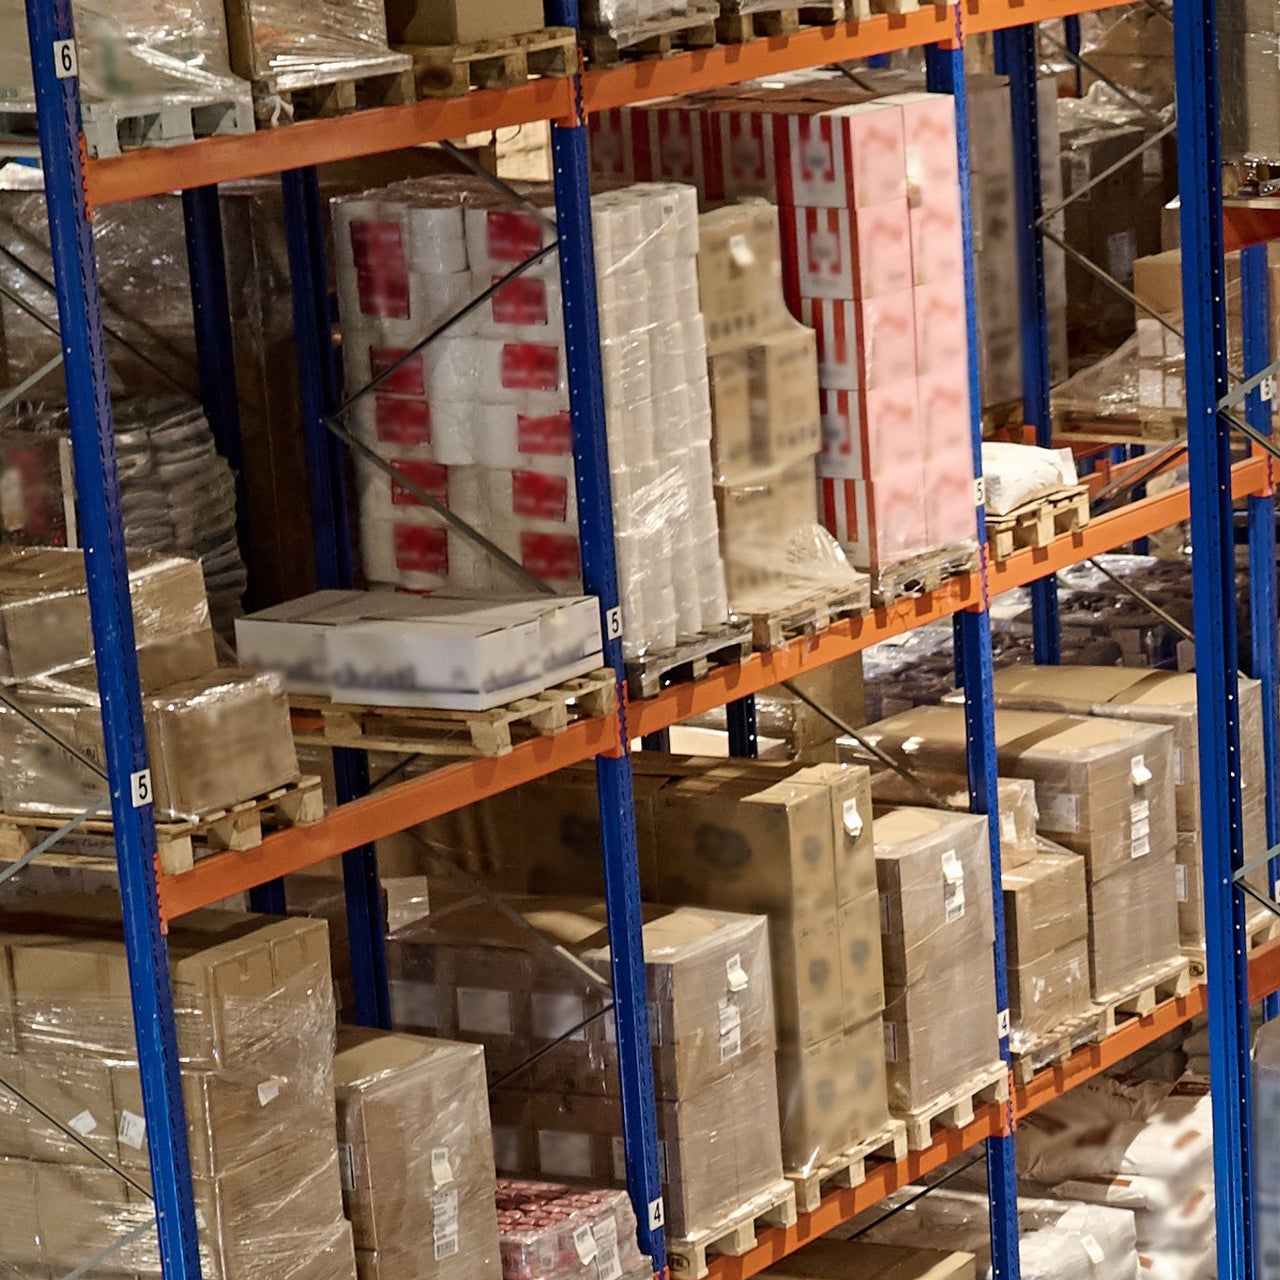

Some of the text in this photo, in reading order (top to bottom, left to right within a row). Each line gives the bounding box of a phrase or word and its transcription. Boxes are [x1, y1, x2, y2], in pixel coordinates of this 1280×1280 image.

[61, 44, 72, 72] 6
[976, 481, 983, 501] 5
[612, 611, 620, 633] 5
[138, 774, 148, 800] 5
[1001, 1015, 1007, 1031] 4
[653, 1201, 661, 1222] 4
